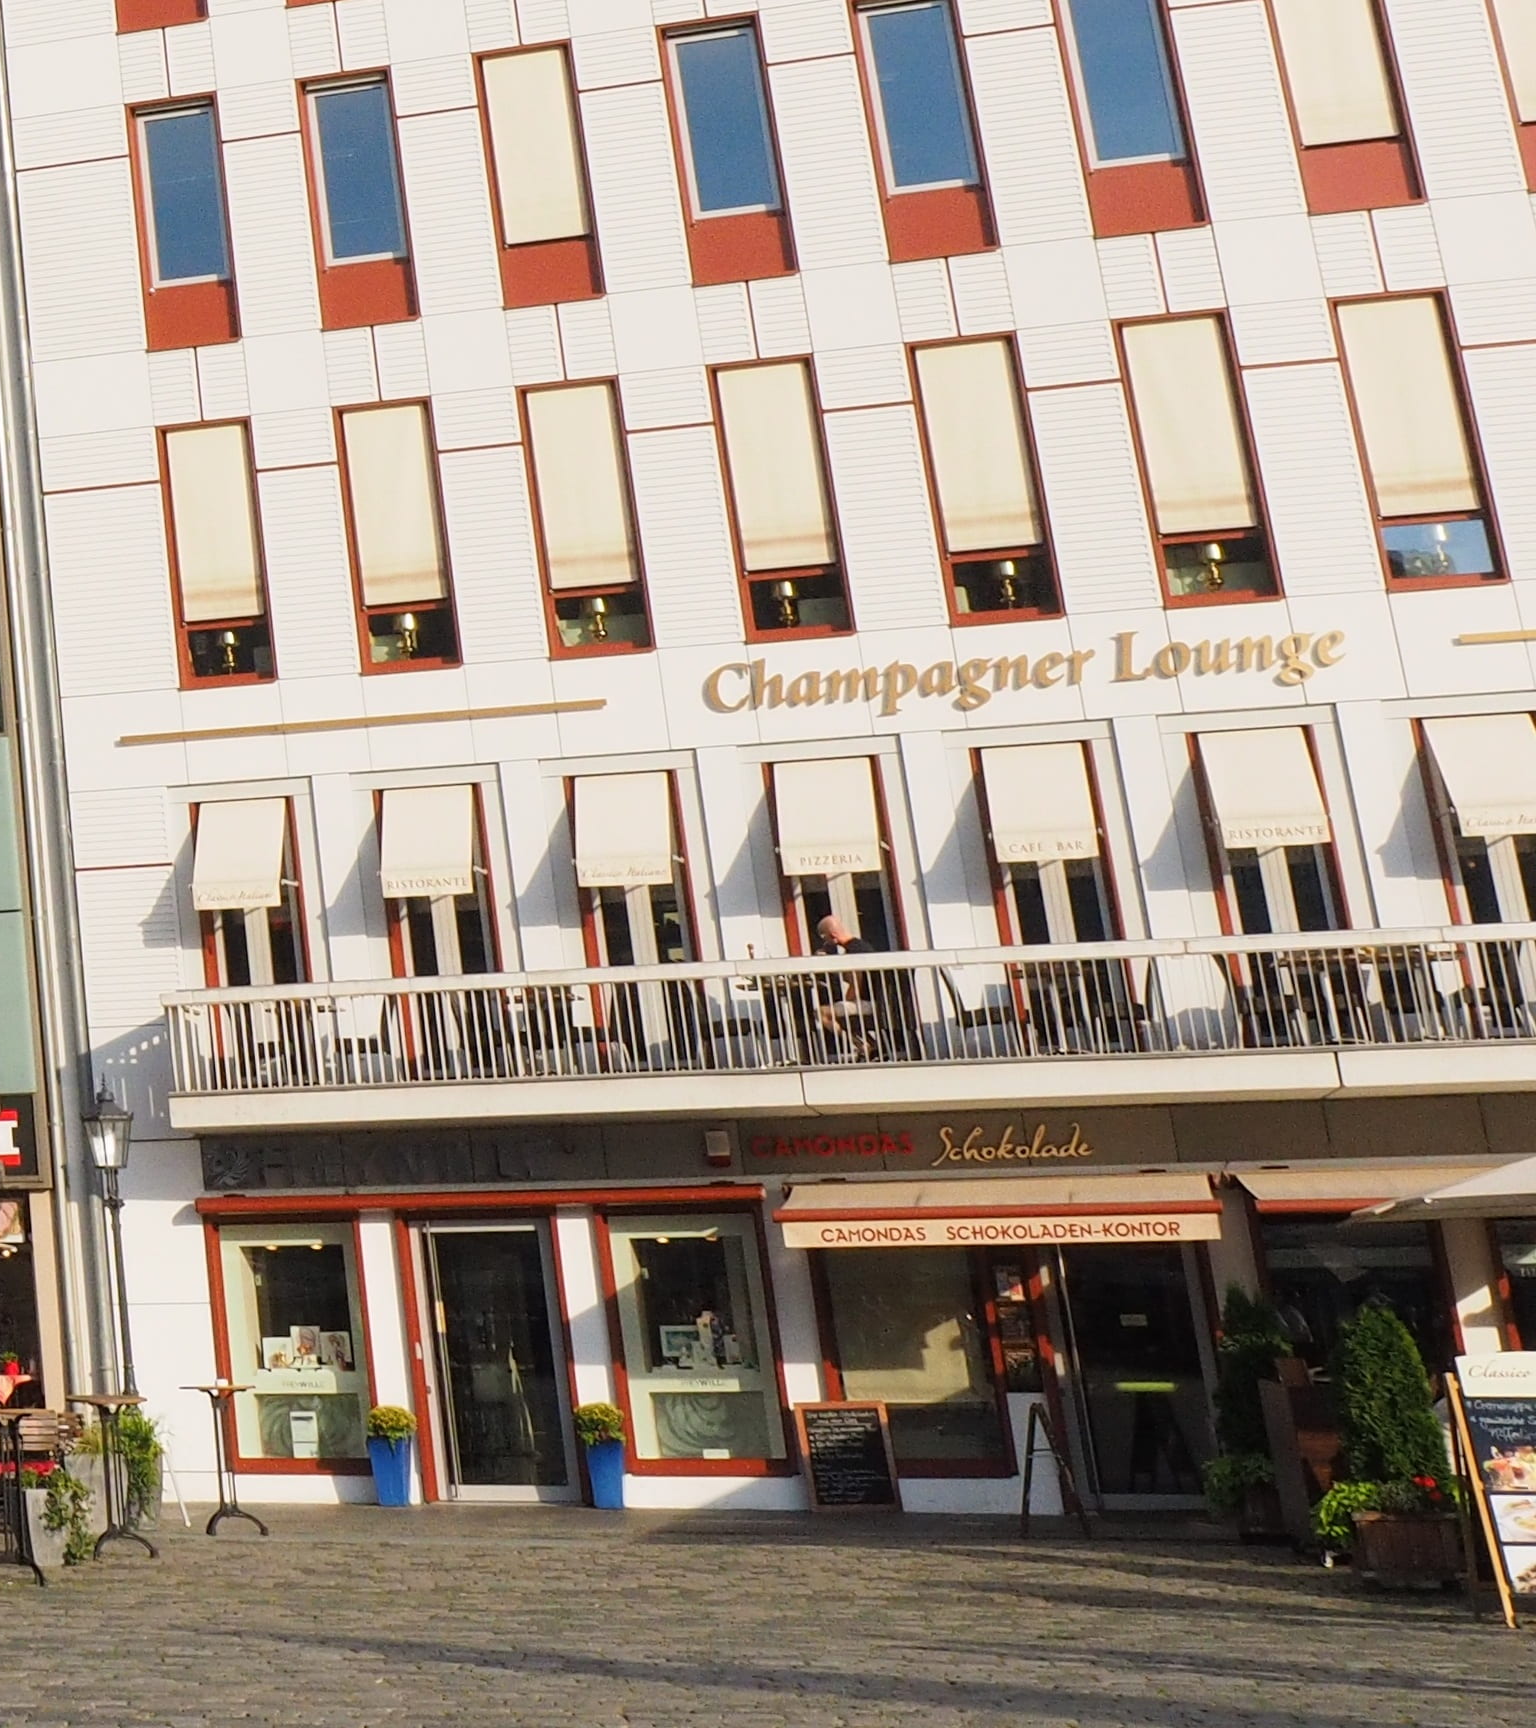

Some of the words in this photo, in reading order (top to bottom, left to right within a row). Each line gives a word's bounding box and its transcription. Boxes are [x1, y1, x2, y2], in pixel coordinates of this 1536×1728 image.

[702, 648, 1095, 718] Champagner
[1110, 627, 1347, 686] Lounge
[1229, 825, 1325, 840] RISTORANTE
[800, 854, 863, 866] PIZZERIA
[387, 877, 468, 890] RISTORANTE
[751, 1132, 915, 1158] CAMONDAS
[931, 1122, 1094, 1166] Schokolade
[821, 1226, 927, 1243] CAMONDAS
[946, 1220, 1182, 1241] SCHOKOLADEN-KONTOR
